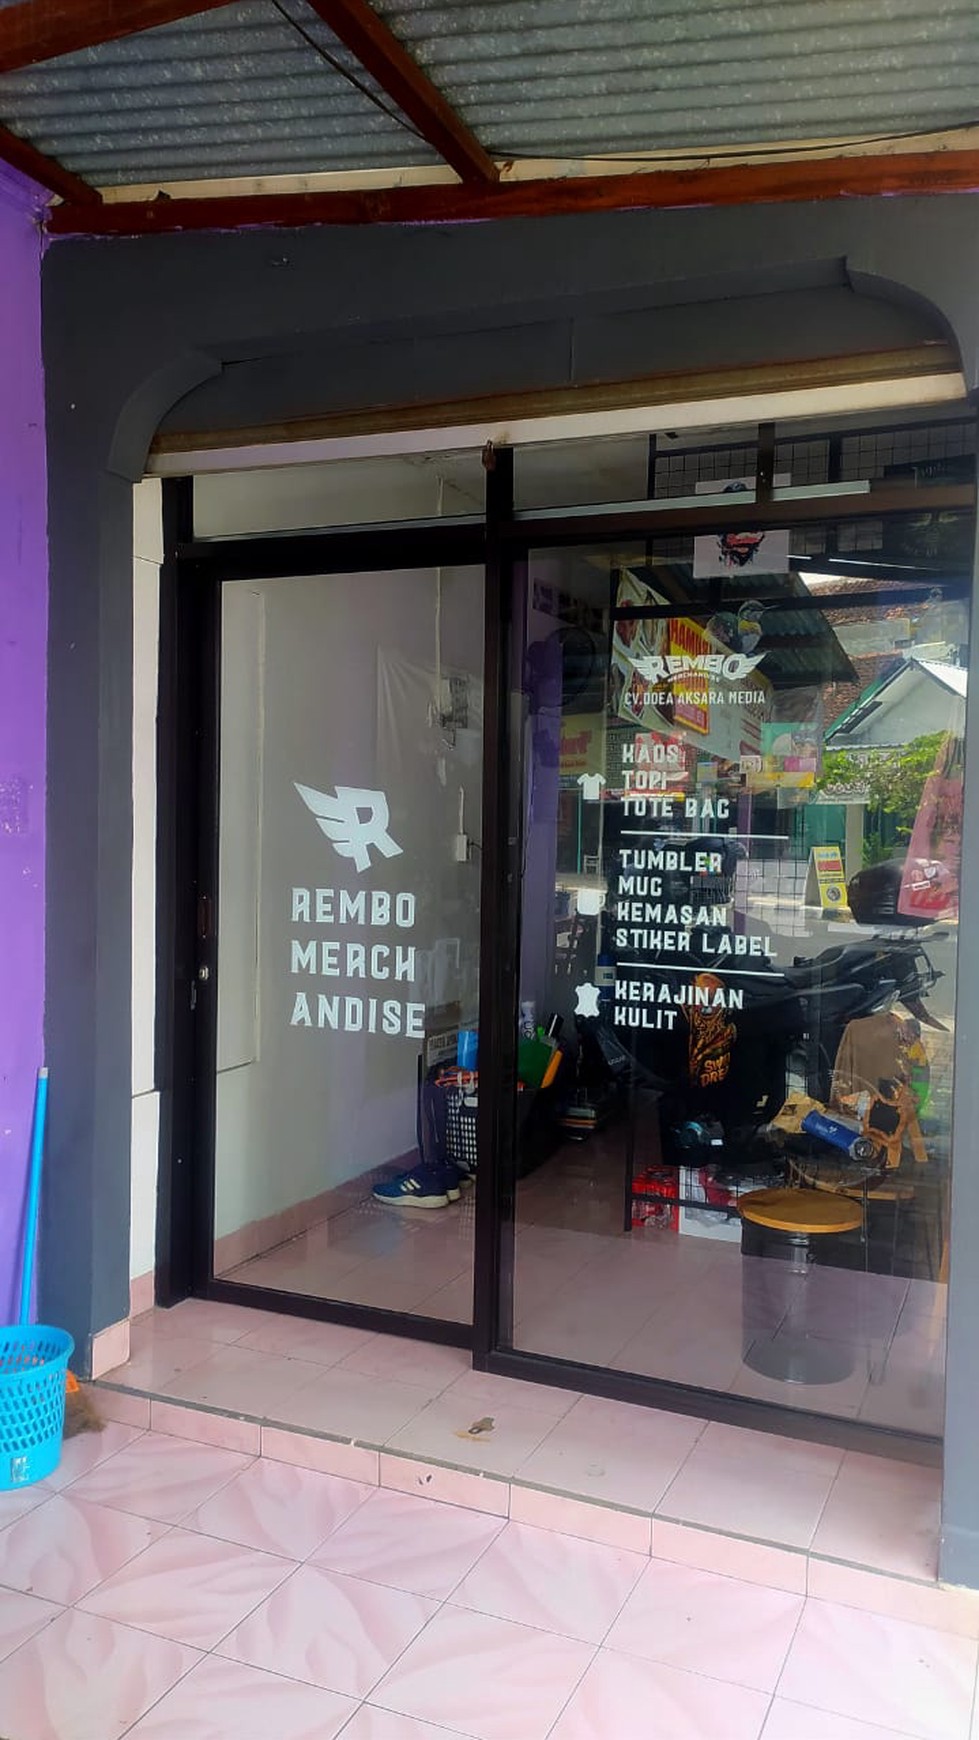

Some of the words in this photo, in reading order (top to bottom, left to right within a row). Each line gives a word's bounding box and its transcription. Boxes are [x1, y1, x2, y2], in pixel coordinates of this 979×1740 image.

[643, 653, 746, 684] REMBO
[678, 691, 724, 705] AKSARA
[728, 690, 765, 705] MEDIA
[622, 743, 680, 764] KAOS
[622, 769, 667, 790] TOPI
[621, 797, 676, 818] TOTE
[685, 798, 730, 819] BAG
[618, 848, 722, 873] TUMBLER
[617, 876, 663, 897] MUG
[291, 887, 417, 929] REMBO
[617, 902, 727, 927] KEMASAN
[615, 927, 690, 952] STIKER
[701, 932, 778, 957] LABEL
[290, 939, 417, 983] MERCH
[614, 979, 744, 1010] KERAJINAN
[289, 991, 426, 1039] ANDISE
[613, 1005, 678, 1030] KULIT
